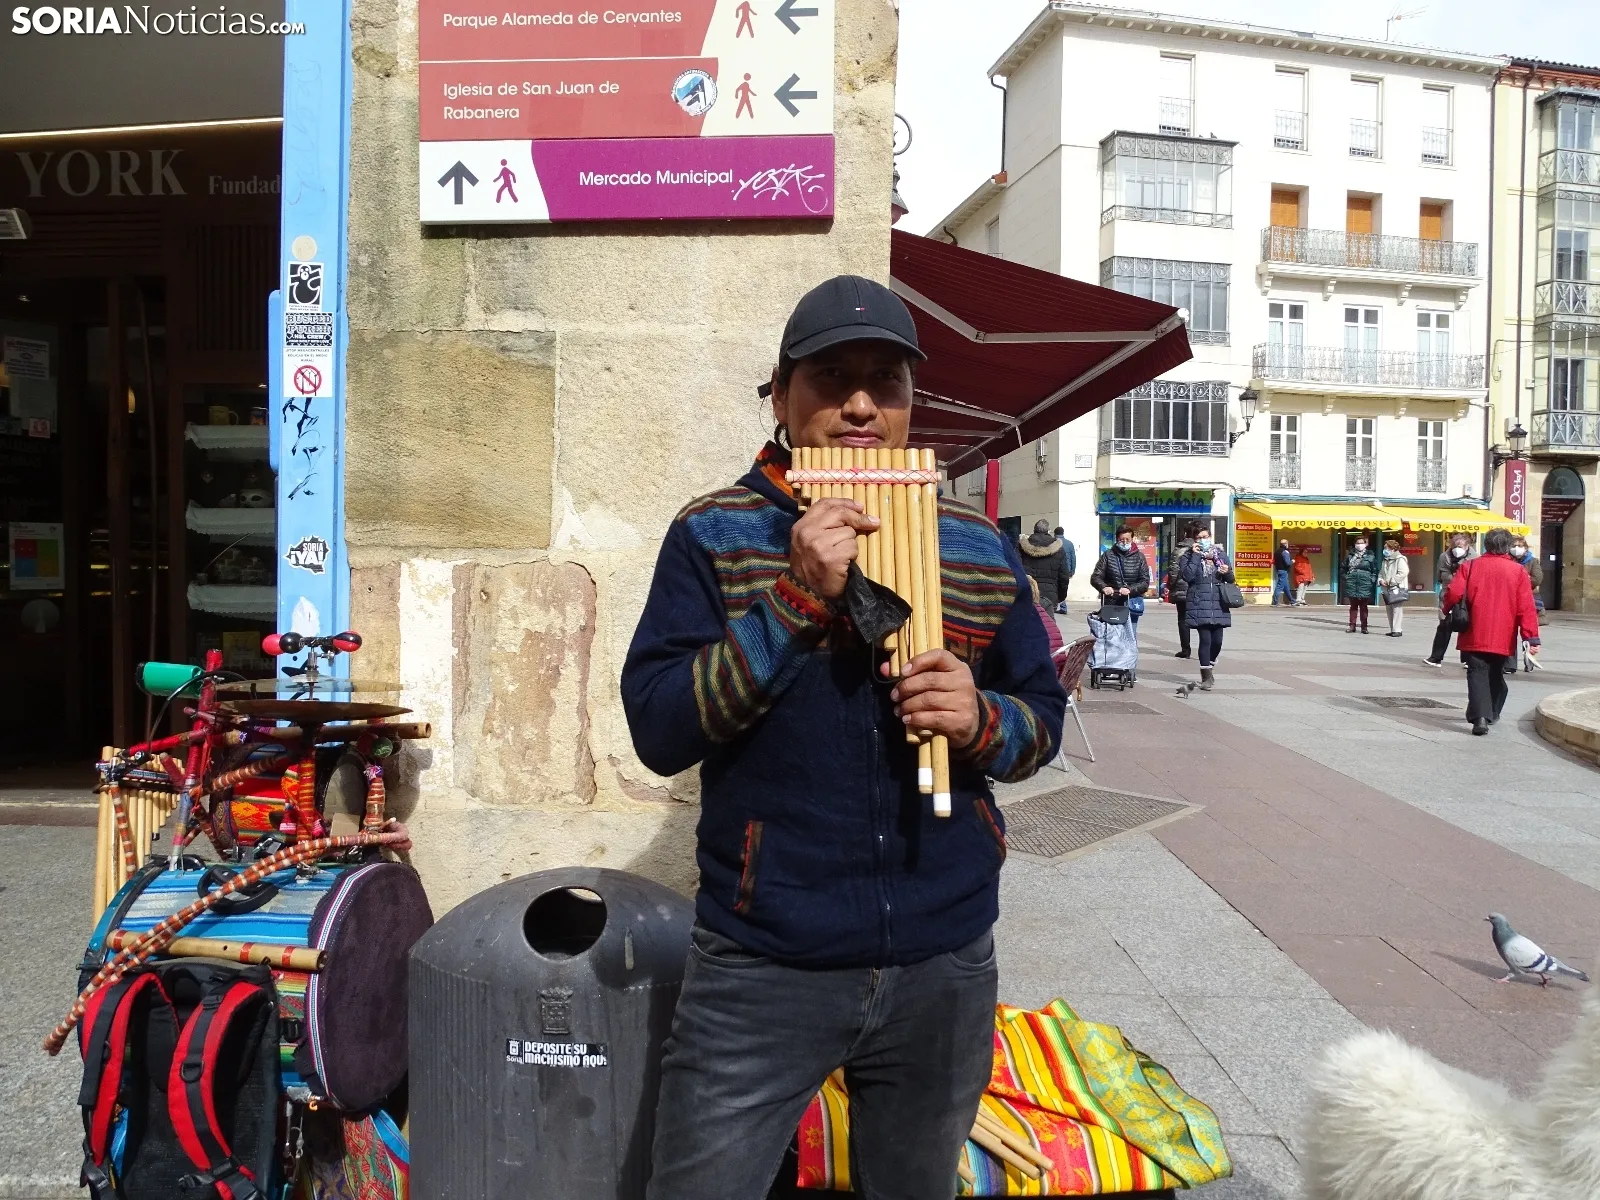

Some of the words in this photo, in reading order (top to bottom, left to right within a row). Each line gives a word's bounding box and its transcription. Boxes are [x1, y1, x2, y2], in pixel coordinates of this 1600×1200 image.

[443, 12, 498, 29] Parque
[501, 11, 574, 26] Alameda
[577, 10, 599, 25] de
[602, 9, 683, 25] Cervantes
[442, 82, 493, 100] Iglesia
[497, 82, 518, 96] de
[522, 81, 552, 96] San
[555, 81, 595, 95] Juan
[598, 80, 620, 94] de
[443, 106, 520, 120] Rabanera
[15, 149, 188, 198] YORK
[579, 170, 652, 186] Mercado
[656, 168, 733, 186] Municipal
[287, 315, 331, 323] BUSTED
[303, 543, 323, 551] SORIA
[1238, 552, 1269, 560] Fotocopias
[525, 1042, 571, 1055] DEPOSITE
[573, 1043, 588, 1055] SU
[525, 1053, 580, 1065] MACHISMO
